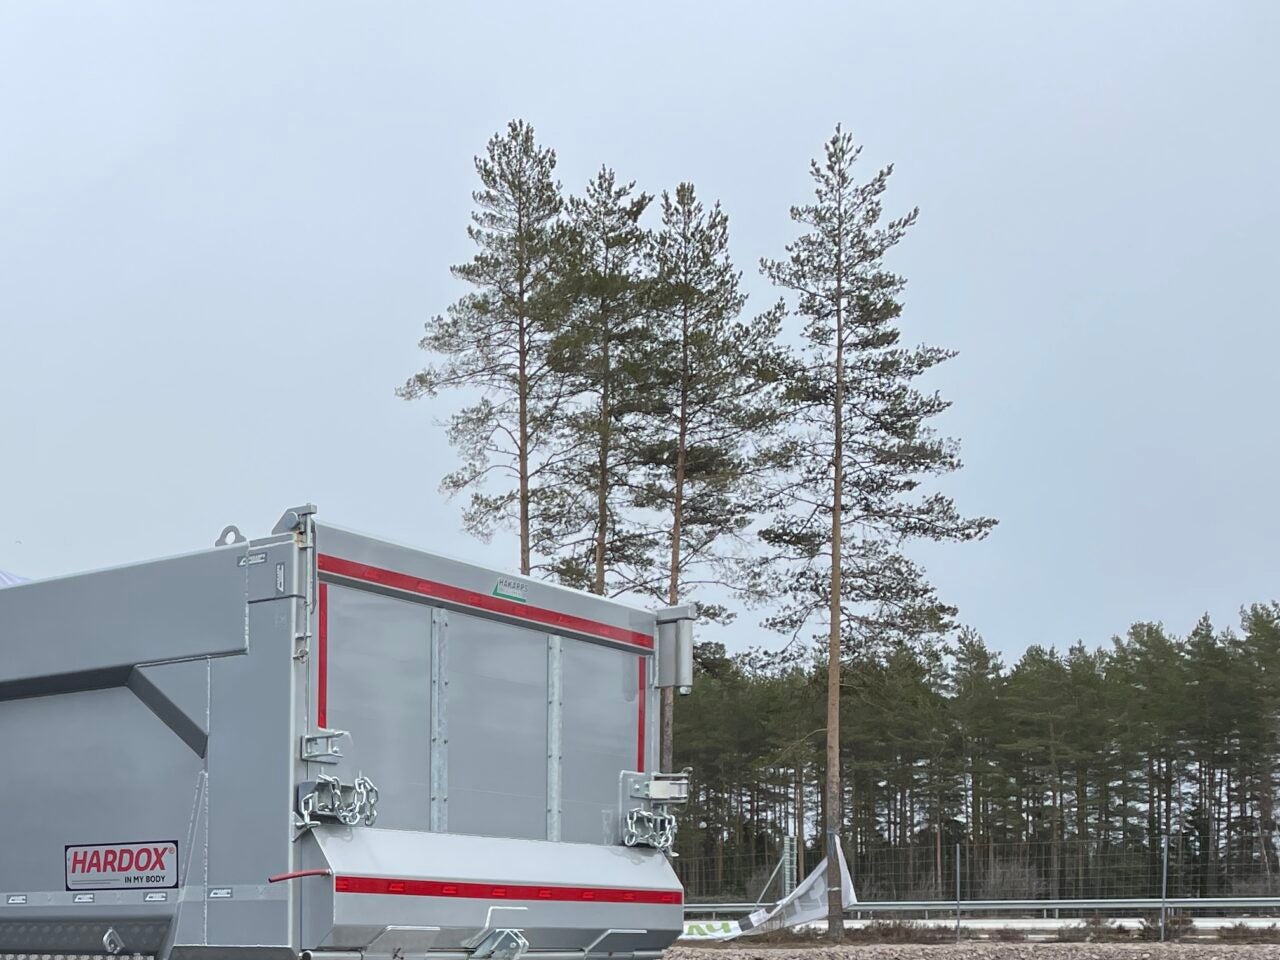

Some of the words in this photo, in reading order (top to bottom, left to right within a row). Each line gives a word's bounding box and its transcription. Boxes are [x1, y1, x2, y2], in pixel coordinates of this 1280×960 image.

[71, 847, 169, 874] HARDOX
[133, 875, 144, 883] MY
[145, 875, 166, 883] BODY
